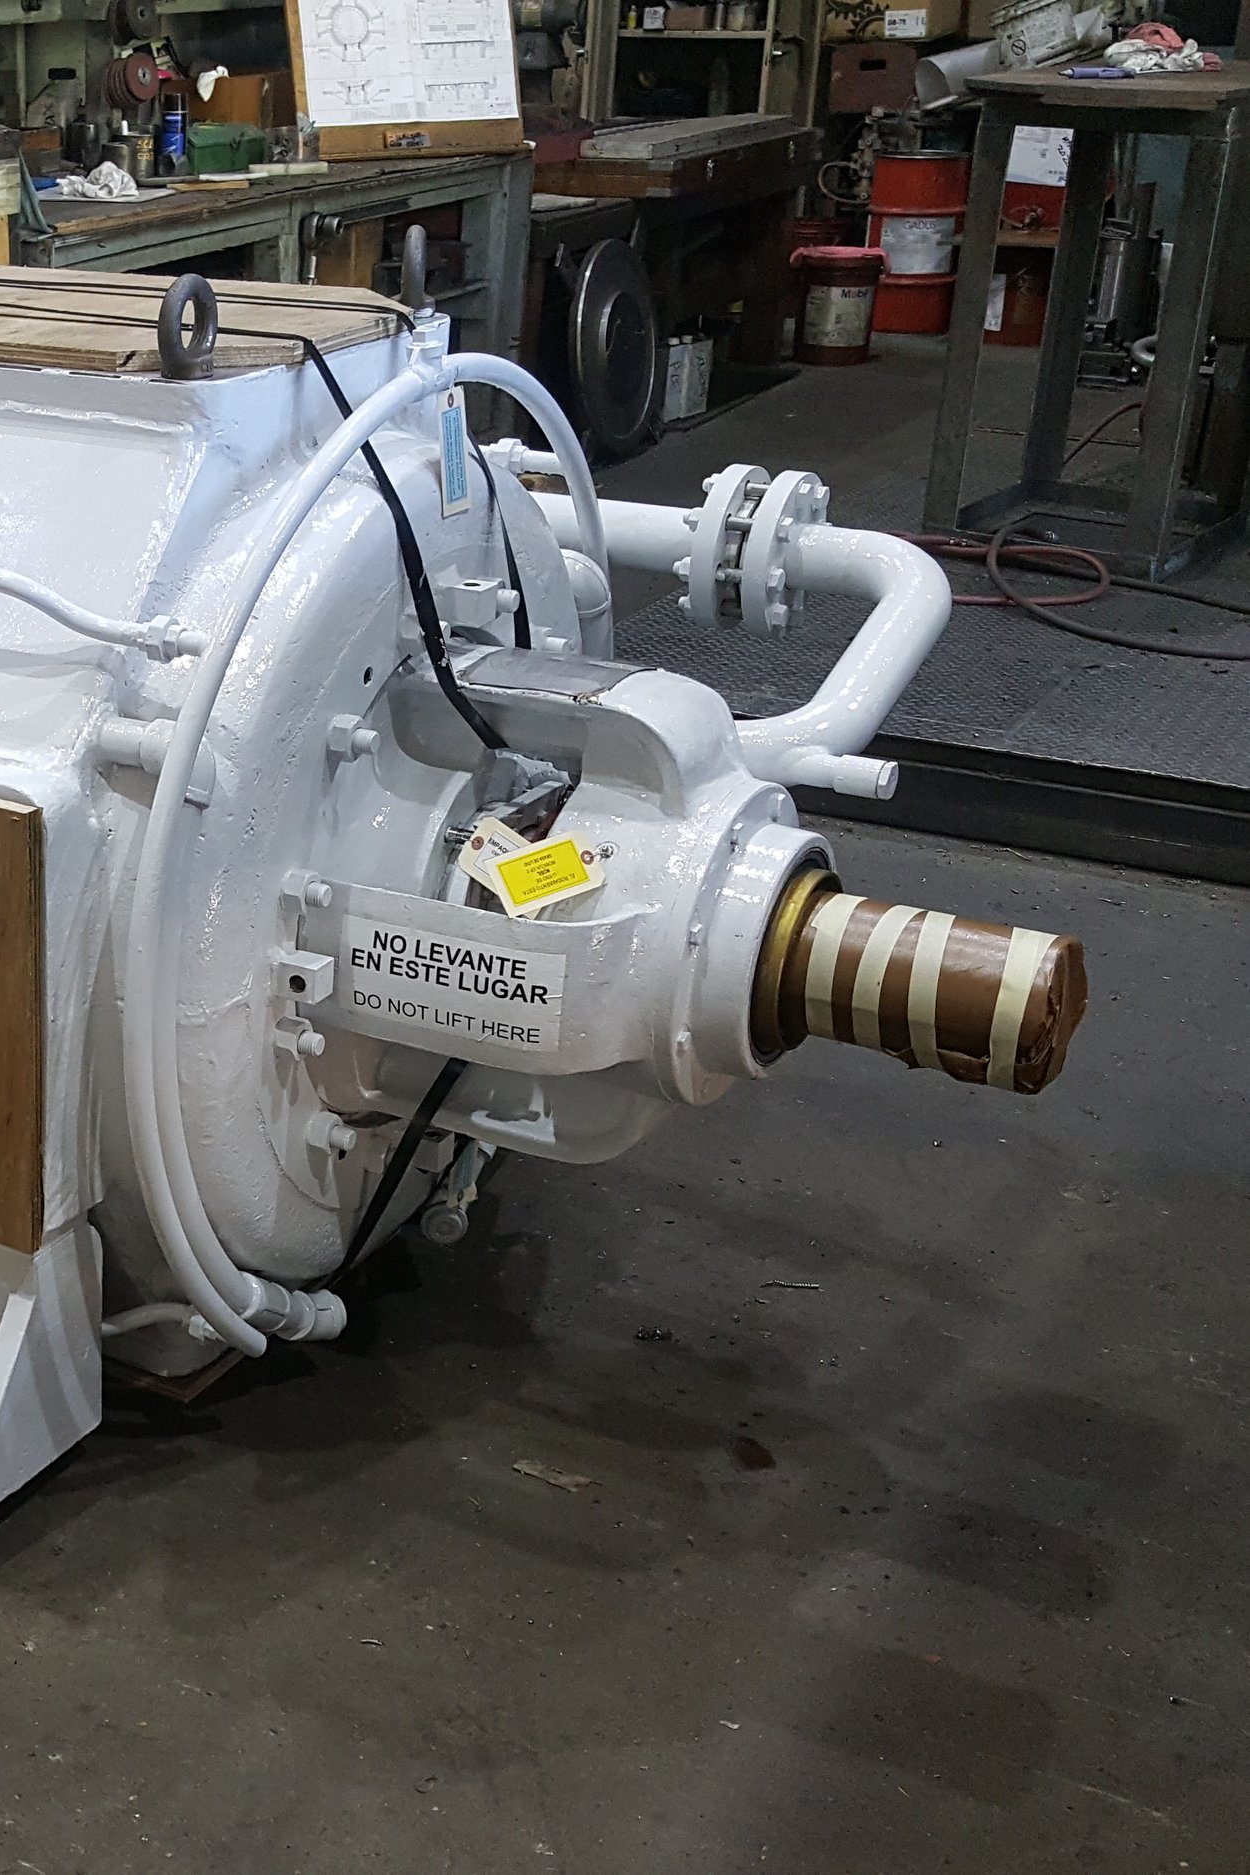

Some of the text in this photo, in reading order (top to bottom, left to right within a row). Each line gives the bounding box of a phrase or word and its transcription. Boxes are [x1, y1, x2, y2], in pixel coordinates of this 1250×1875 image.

[487, 837, 509, 854] EMPAQ
[351, 947, 549, 1005] EN ESTE LUGAR
[372, 930, 527, 980] NO LEVANTE
[353, 990, 541, 1044] DO NOT LIFT HERE
